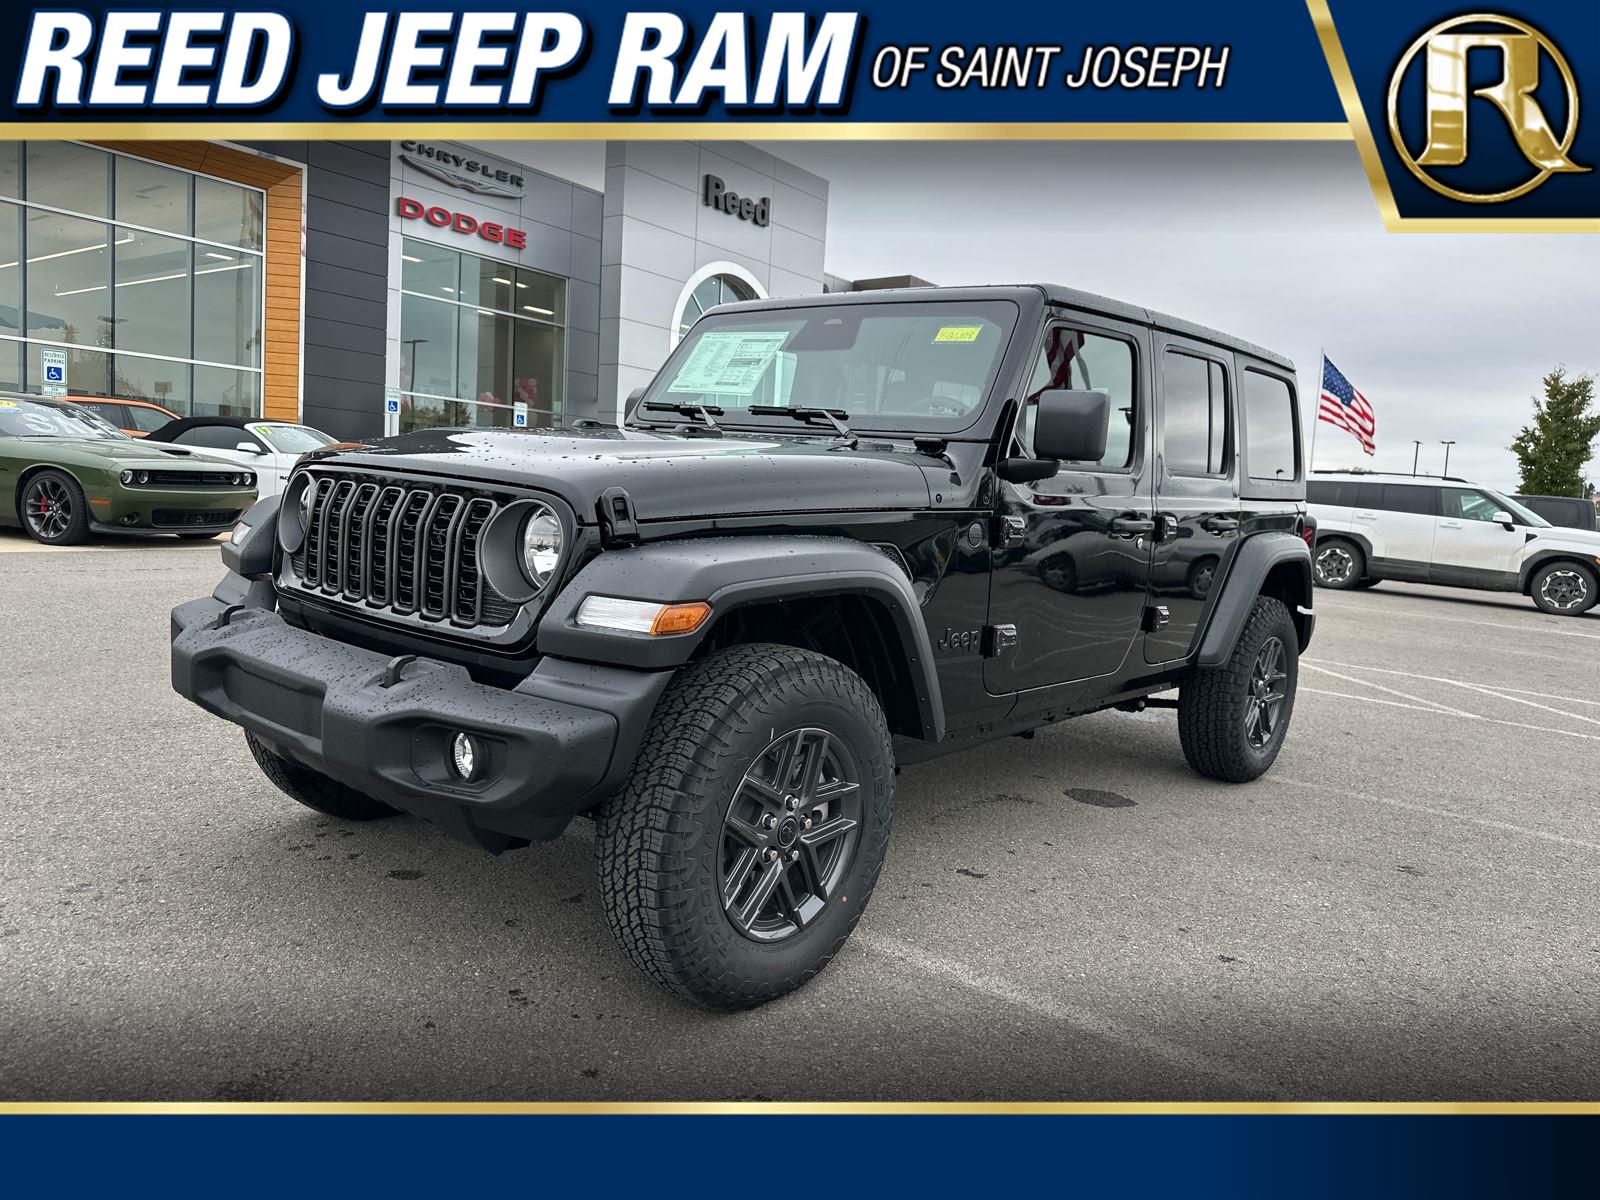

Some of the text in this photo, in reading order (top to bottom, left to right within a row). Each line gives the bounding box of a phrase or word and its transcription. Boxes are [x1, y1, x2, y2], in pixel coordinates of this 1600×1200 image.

[400, 140, 524, 187] CHRYSLER
[396, 197, 526, 249] DODGE
[704, 174, 770, 227] Reed
[938, 626, 979, 652] Jeep
